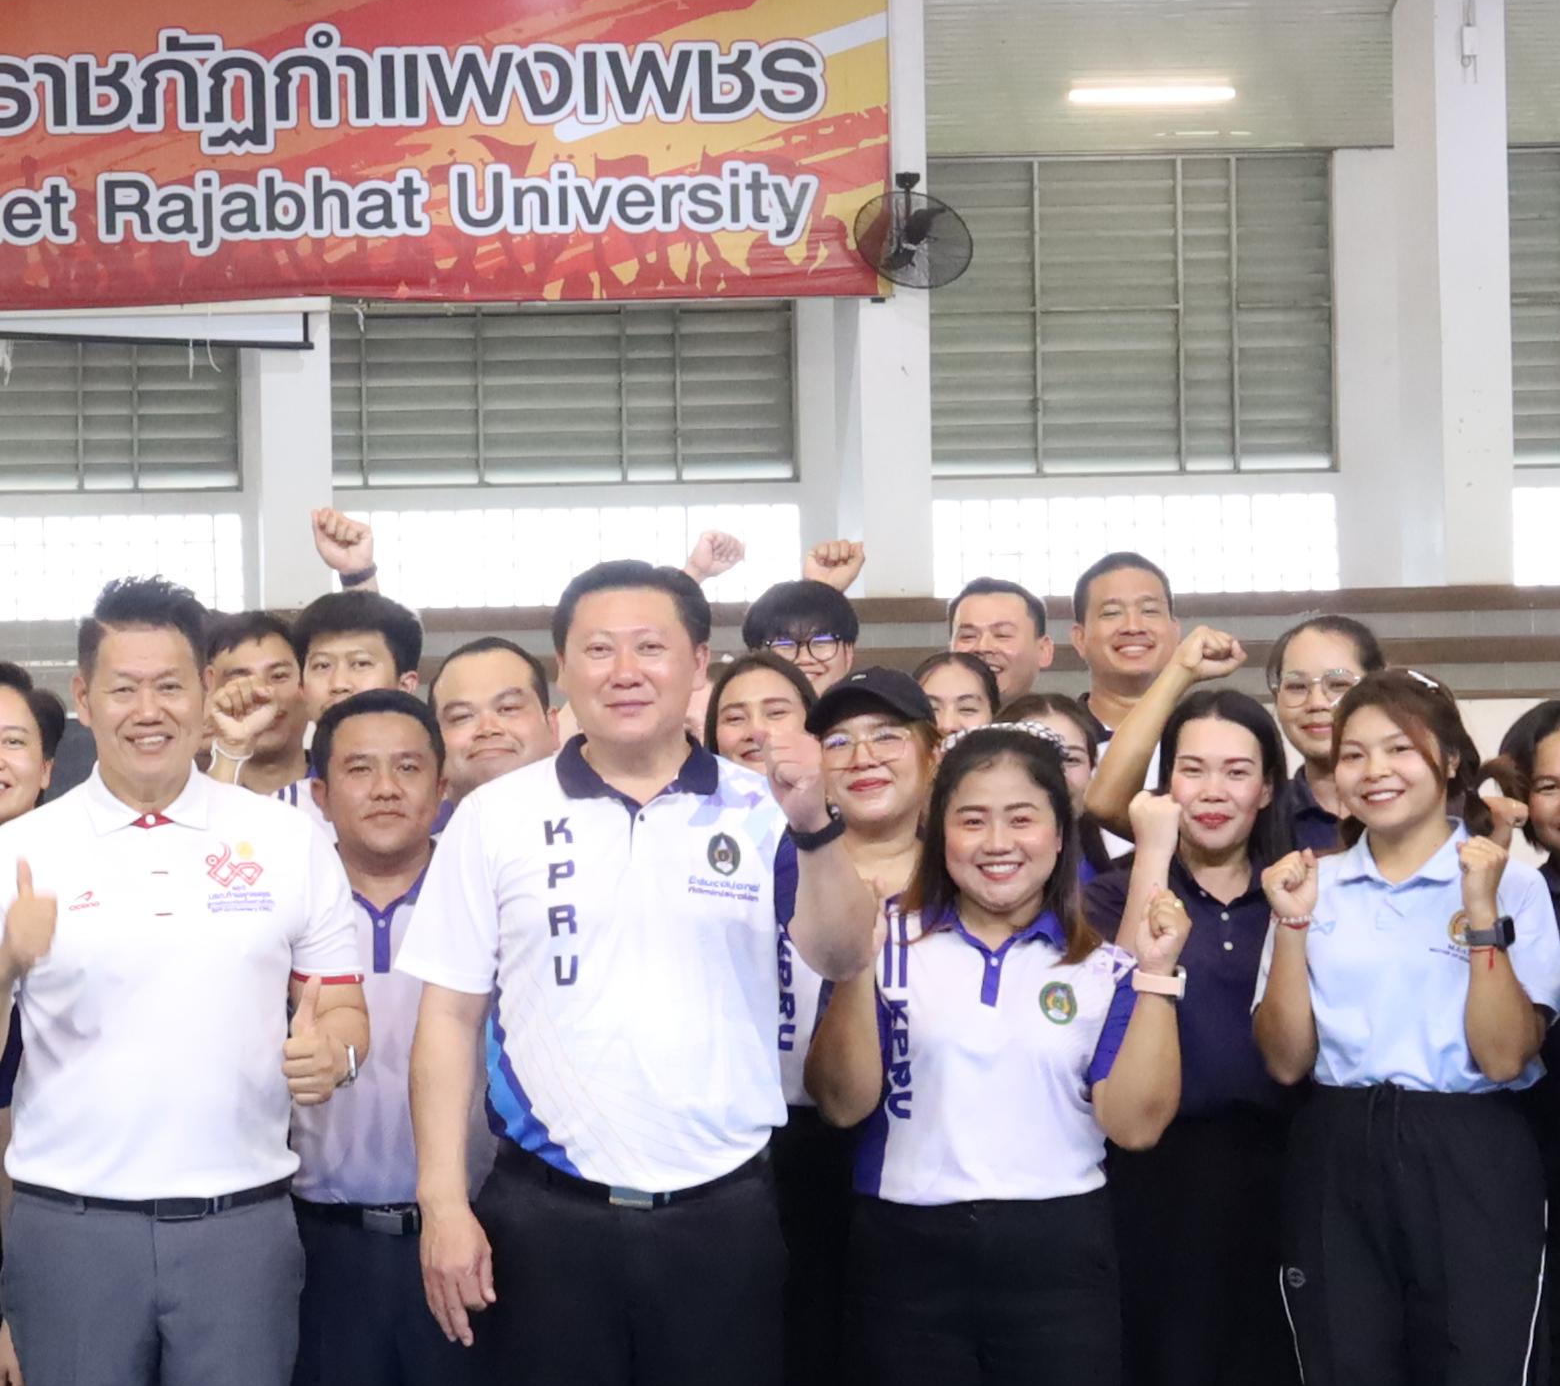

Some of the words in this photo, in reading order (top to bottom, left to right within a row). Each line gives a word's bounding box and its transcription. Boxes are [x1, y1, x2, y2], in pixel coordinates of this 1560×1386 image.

[104, 175, 423, 249] Rajabhat
[457, 167, 811, 240] University
[544, 817, 578, 987] KPRU
[887, 1000, 913, 1120] KPRU
